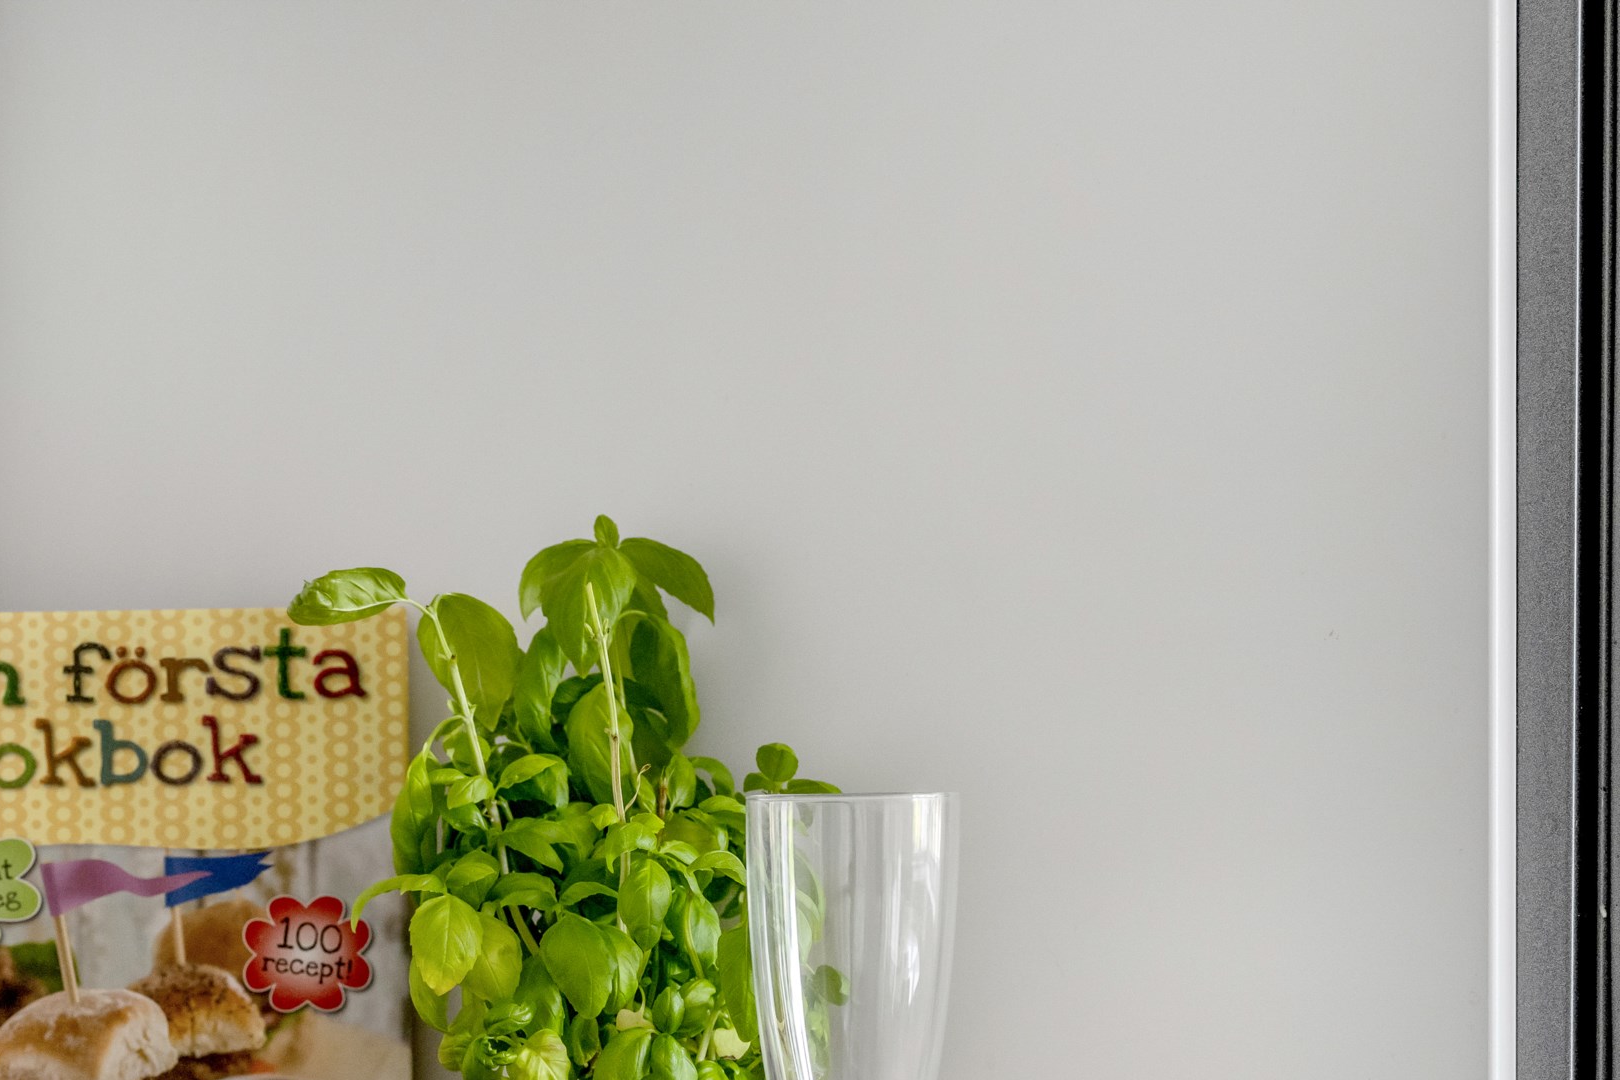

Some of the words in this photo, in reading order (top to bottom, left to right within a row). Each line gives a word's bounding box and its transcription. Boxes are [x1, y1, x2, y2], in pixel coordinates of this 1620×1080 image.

[63, 628, 368, 705] första
[277, 916, 342, 954] 100
[261, 956, 354, 985] recept!
